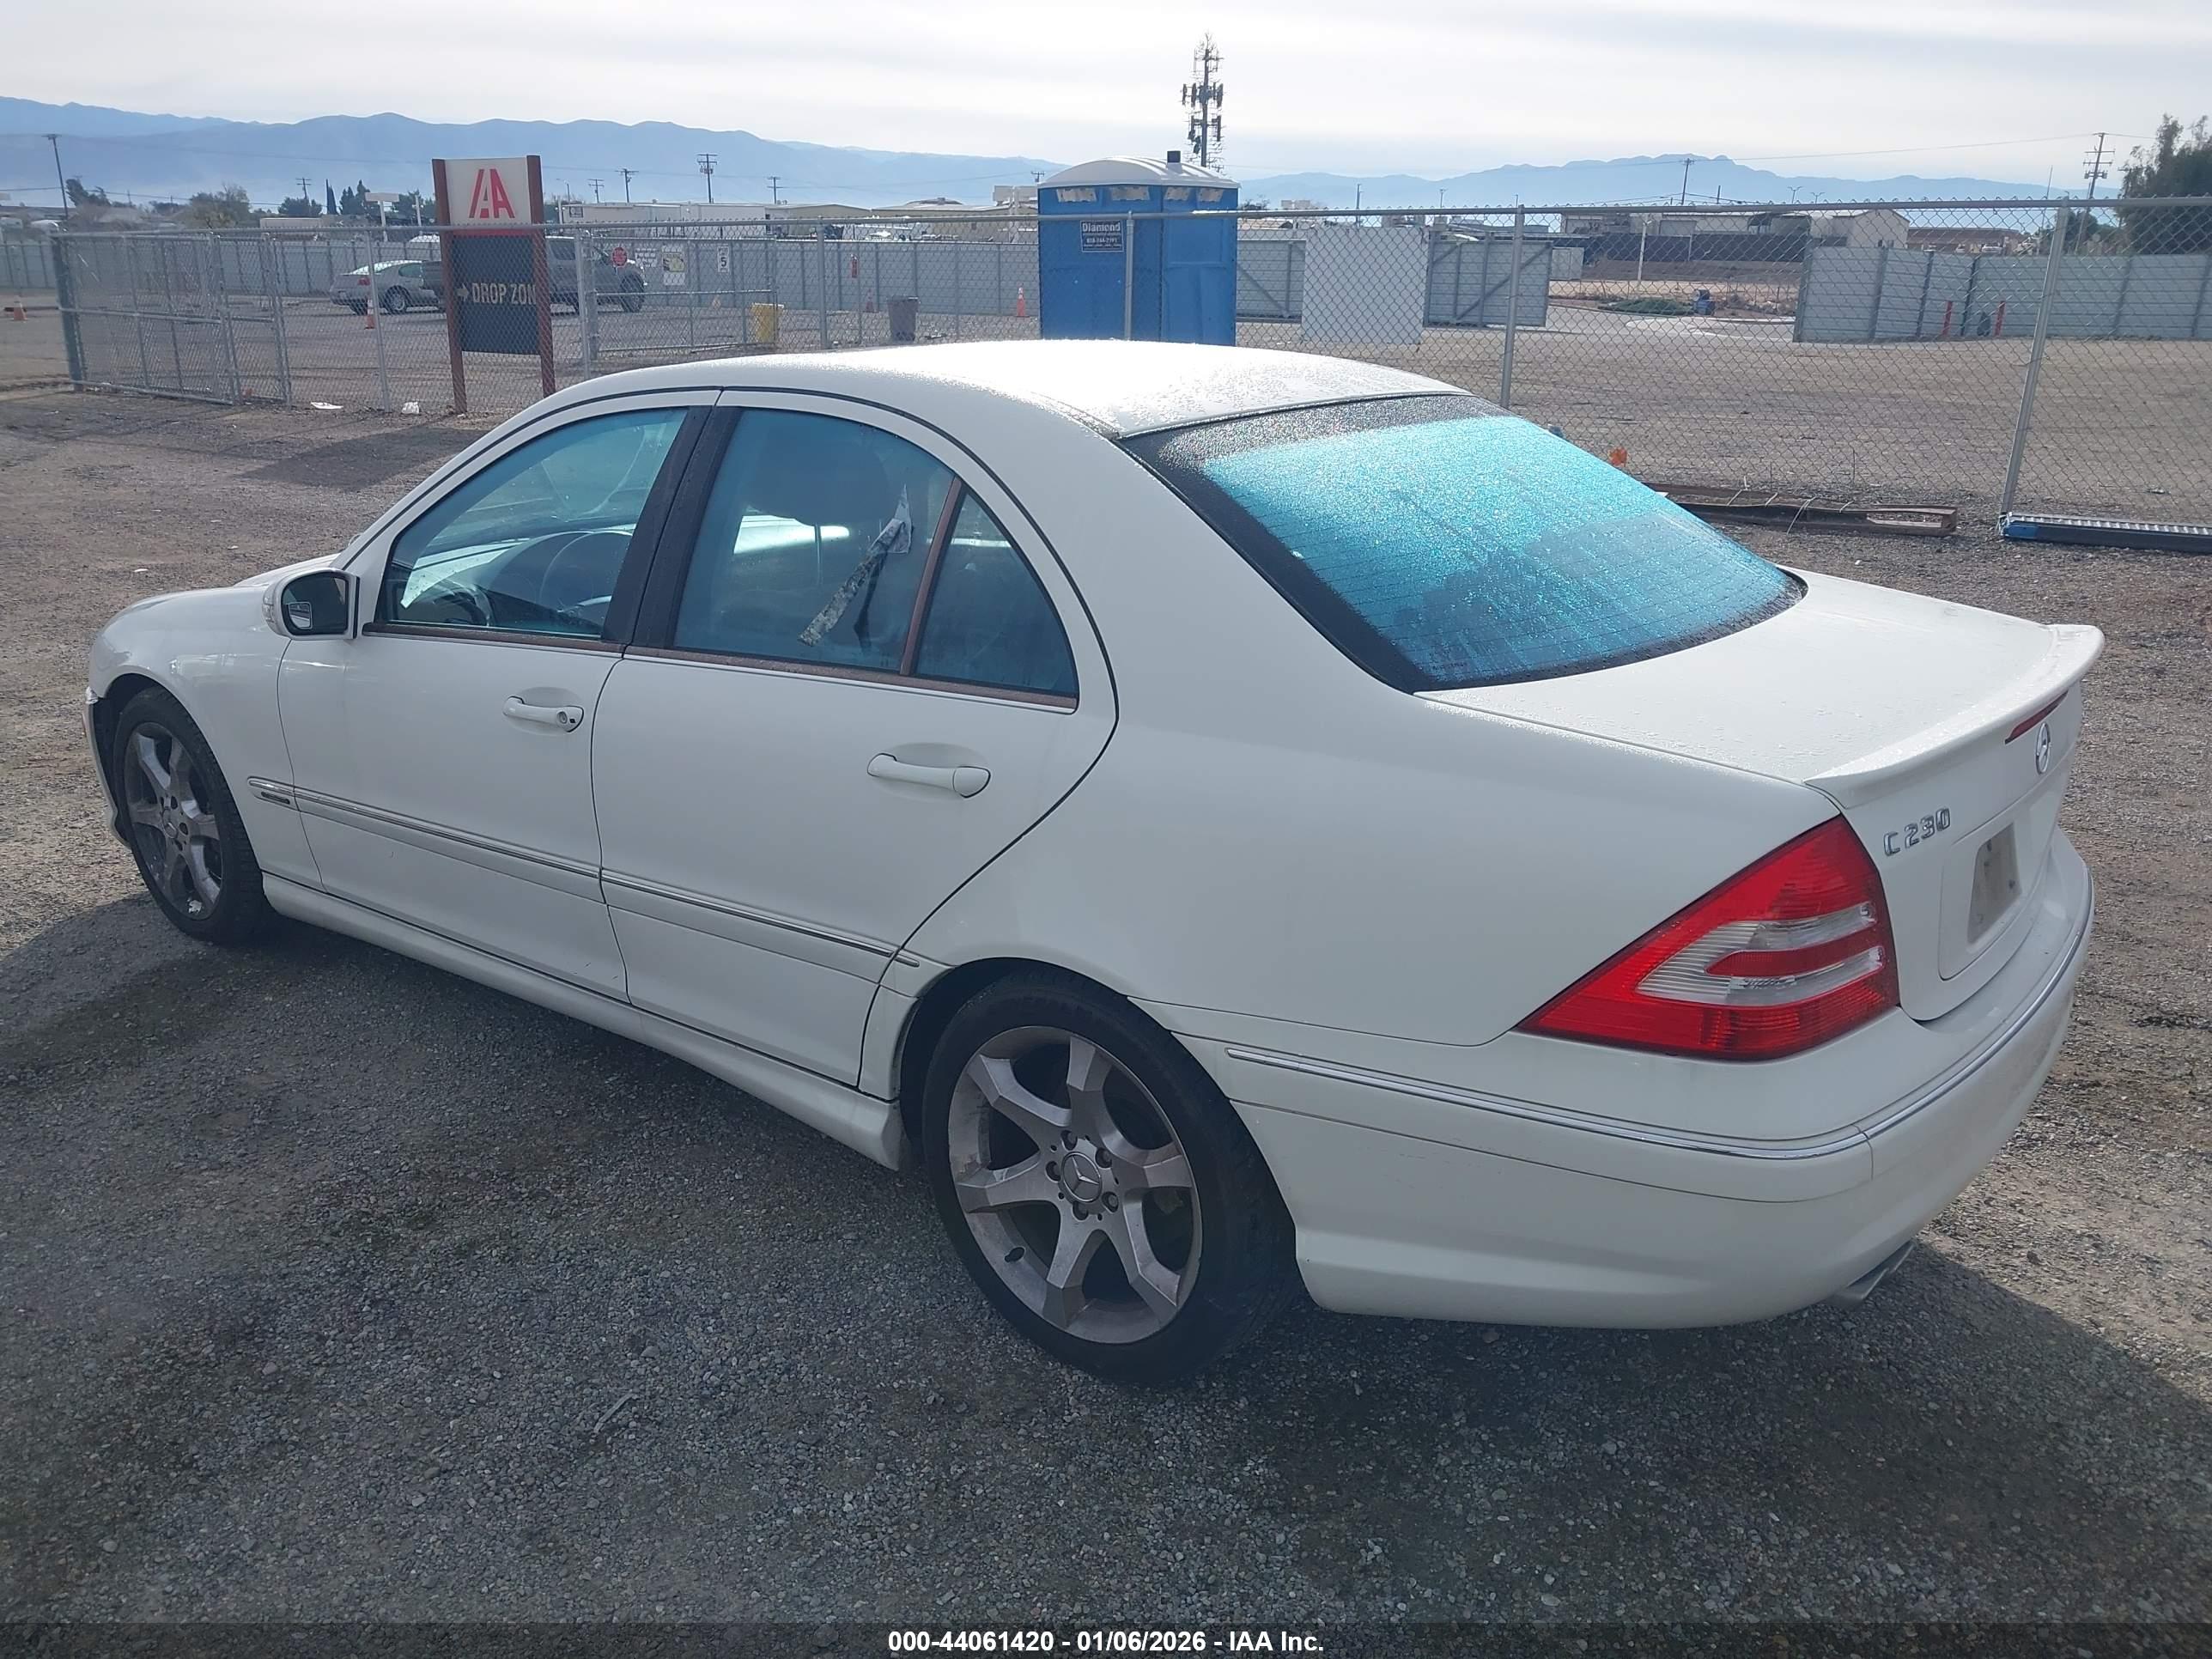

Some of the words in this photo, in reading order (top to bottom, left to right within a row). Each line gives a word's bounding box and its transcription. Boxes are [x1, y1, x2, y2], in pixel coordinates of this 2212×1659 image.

[1082, 222, 1121, 232] Diamond
[720, 257, 727, 267] 5
[471, 283, 507, 304] DROP
[509, 283, 537, 306] ZON
[1883, 831, 1901, 857] C
[1904, 807, 1951, 849] 230
